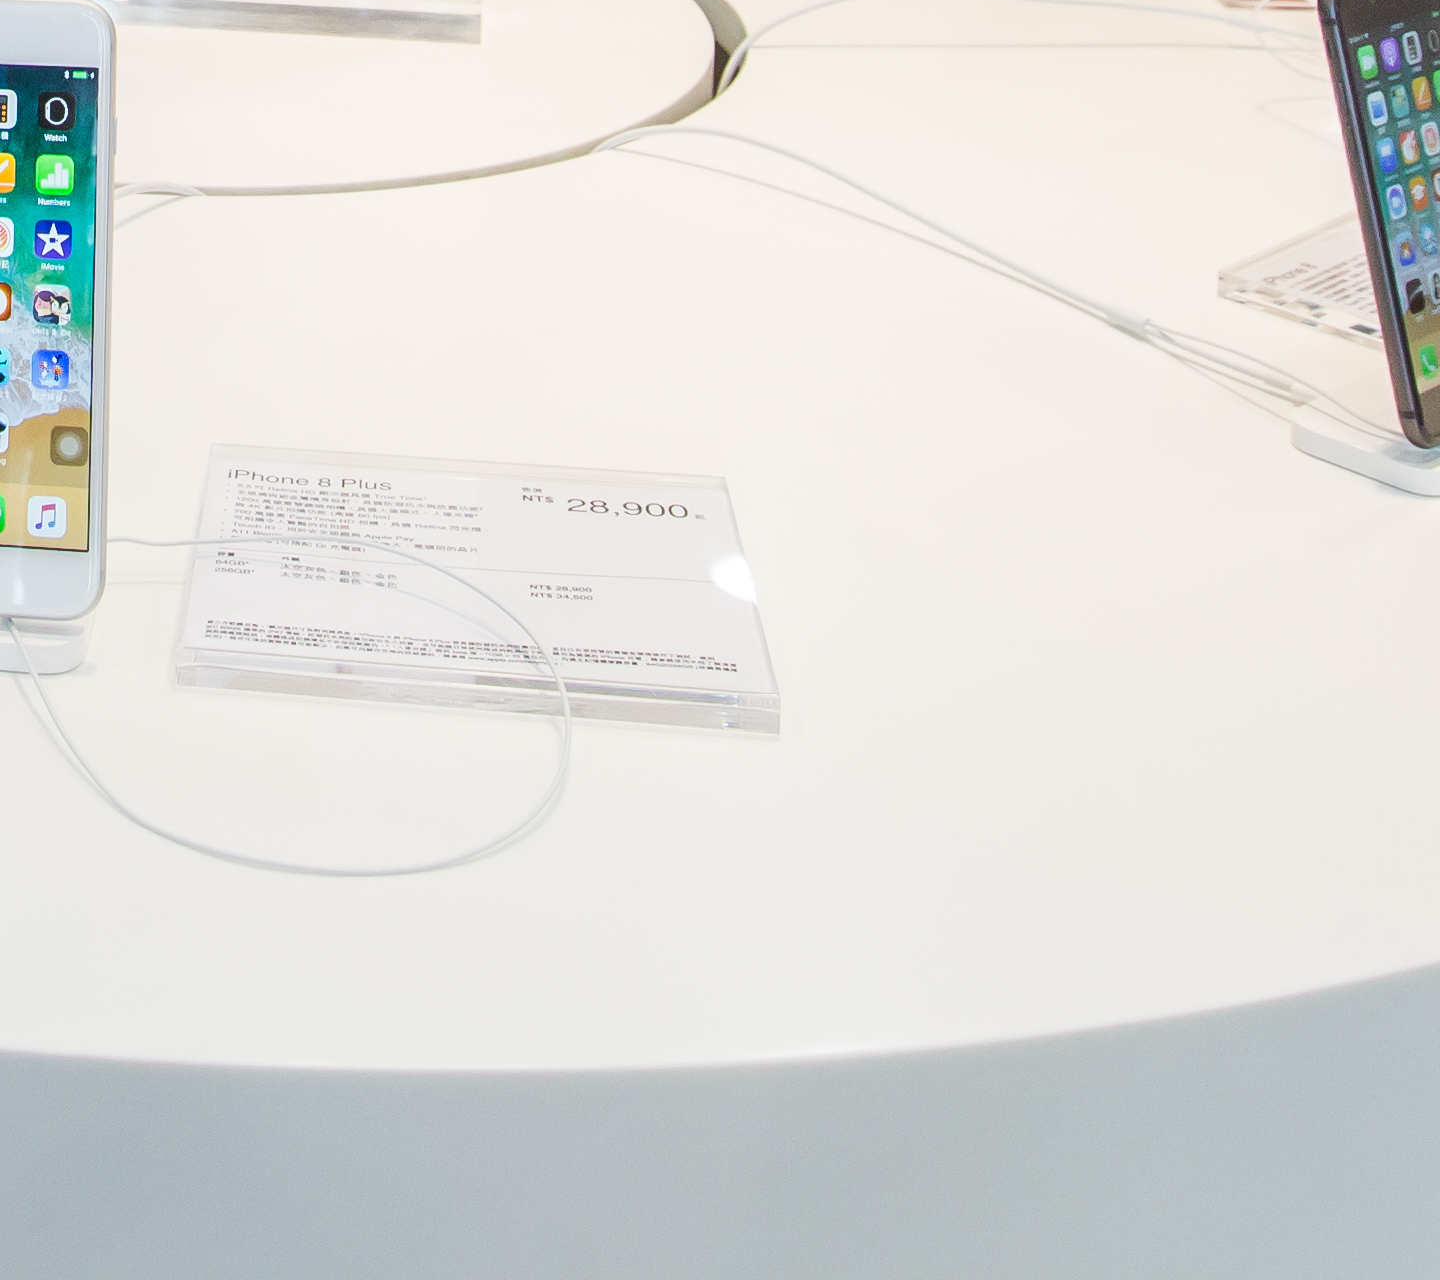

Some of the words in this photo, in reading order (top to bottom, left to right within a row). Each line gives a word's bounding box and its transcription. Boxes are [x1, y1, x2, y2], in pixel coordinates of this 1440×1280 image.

[44, 133, 67, 142] Watch
[37, 197, 71, 207] Numbers
[227, 468, 310, 486] iPhone
[318, 477, 332, 488] 8
[340, 477, 393, 491] Plus
[522, 494, 554, 504] NT$
[567, 498, 689, 519] 28,900
